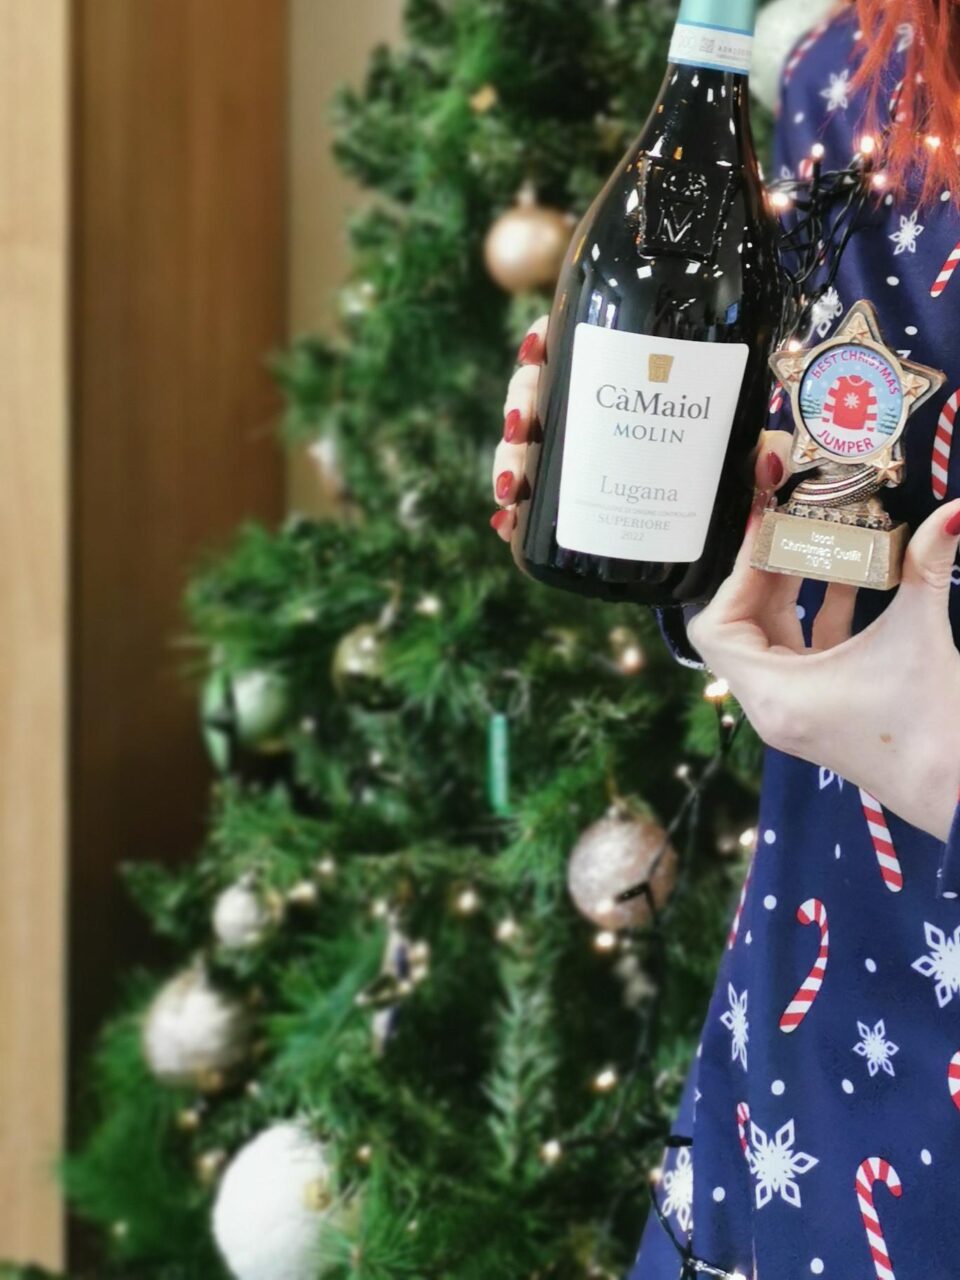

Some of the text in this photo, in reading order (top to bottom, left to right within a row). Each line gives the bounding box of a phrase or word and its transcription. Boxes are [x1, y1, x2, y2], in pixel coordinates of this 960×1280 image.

[811, 349, 900, 395] BEST CHRISTMAS
[596, 383, 711, 420] CàMaiol
[613, 422, 685, 443] MOLIN
[817, 429, 875, 453] JUMPER
[600, 475, 679, 505] Lugana
[597, 513, 672, 531] SUPERIORE
